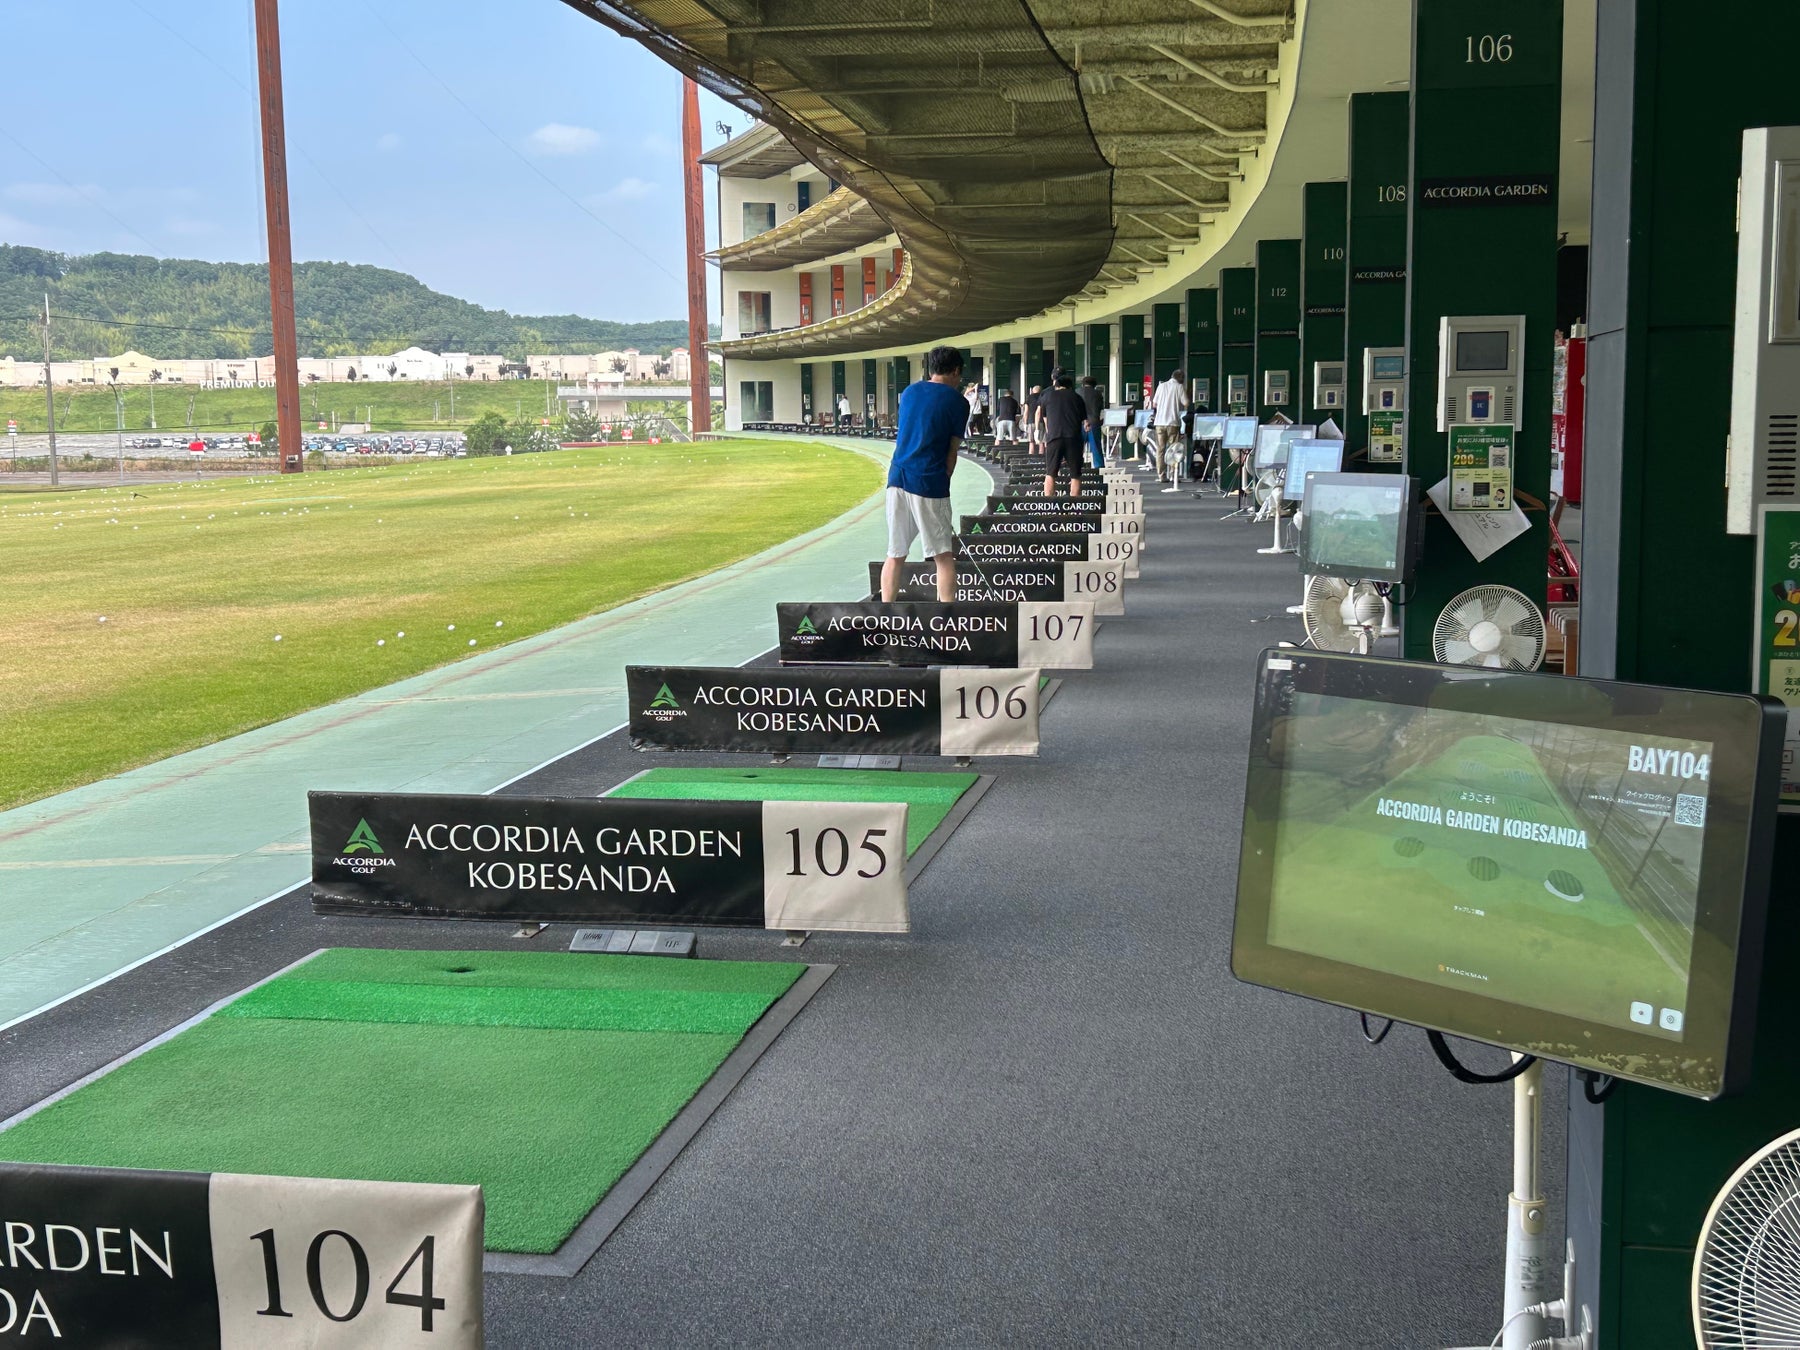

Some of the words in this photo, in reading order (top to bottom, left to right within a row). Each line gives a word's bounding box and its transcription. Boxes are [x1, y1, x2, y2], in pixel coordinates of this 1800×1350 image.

[1465, 34, 1513, 63] 106
[1378, 185, 1406, 202] 108
[1424, 186, 1491, 198] ACCORDIA
[1495, 184, 1548, 197] GARDEN
[1324, 247, 1344, 260] 110
[1355, 271, 1394, 279] ACCORDIA
[1271, 287, 1287, 297] 112
[200, 379, 254, 390] PREMIUM
[1011, 502, 1060, 511] ACCORDIA
[1062, 502, 1101, 511] GARDEN
[1114, 501, 1136, 514] 111
[989, 522, 1047, 533] ACCORDIA
[1050, 522, 1096, 533] GARDEN
[958, 544, 1025, 555] ACCORDIA
[1028, 544, 1081, 555] GARDEN
[1096, 542, 1133, 561] 109
[909, 573, 987, 586] ACCRDIA
[992, 573, 1056, 586] GARDEN
[1073, 571, 1117, 594] 108
[827, 615, 923, 632] ACCORDIA
[929, 616, 1007, 633] GARDEN
[1028, 614, 1084, 641] 107
[862, 633, 972, 652] KOBESANDA
[693, 685, 817, 707] ACCORDIA
[825, 687, 926, 708] GARDEN
[954, 684, 1028, 720] 106
[737, 711, 881, 733] KOBESANDA
[1628, 744, 1709, 781] BAY104
[1376, 797, 1442, 825] ACCORDIA
[1445, 808, 1500, 835] GARDEN
[1503, 817, 1588, 850] KOBESANDA
[404, 823, 585, 857] ACCORDIA
[596, 827, 742, 858] GARDEN
[333, 857, 396, 867] ACCORDIA
[784, 826, 888, 879] 105
[351, 866, 376, 874] GOLF
[468, 861, 676, 895] KOBESANDA
[0, 1222, 173, 1279] RDEN
[250, 1228, 446, 1332] 104
